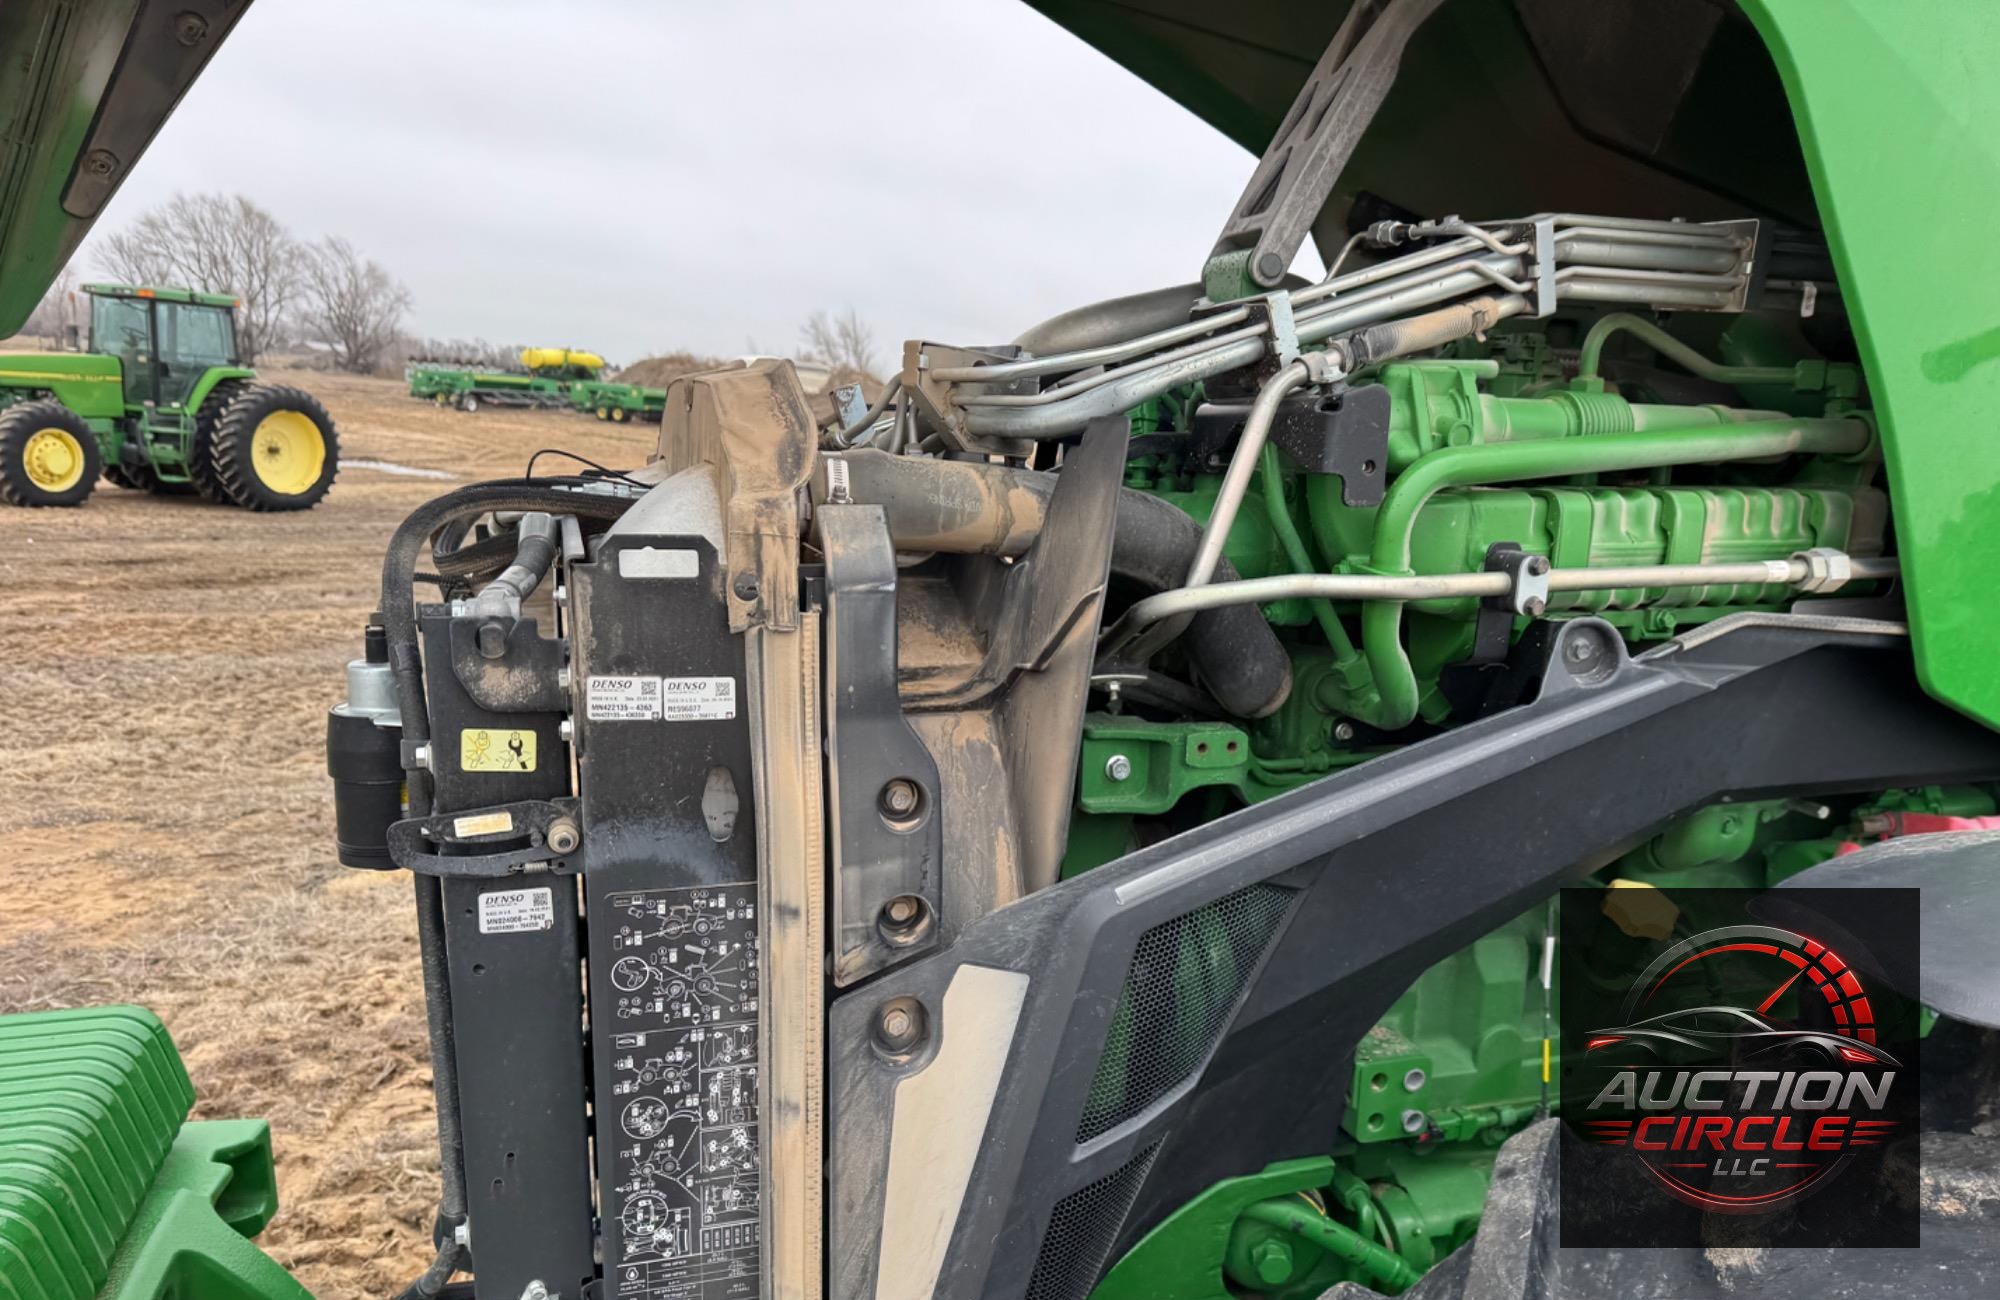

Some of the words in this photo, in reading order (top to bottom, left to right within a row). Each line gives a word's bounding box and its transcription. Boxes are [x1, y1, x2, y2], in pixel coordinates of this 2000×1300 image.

[592, 680, 633, 689] DENSO
[667, 682, 707, 690] DENSO
[486, 894, 524, 904] DENSO
